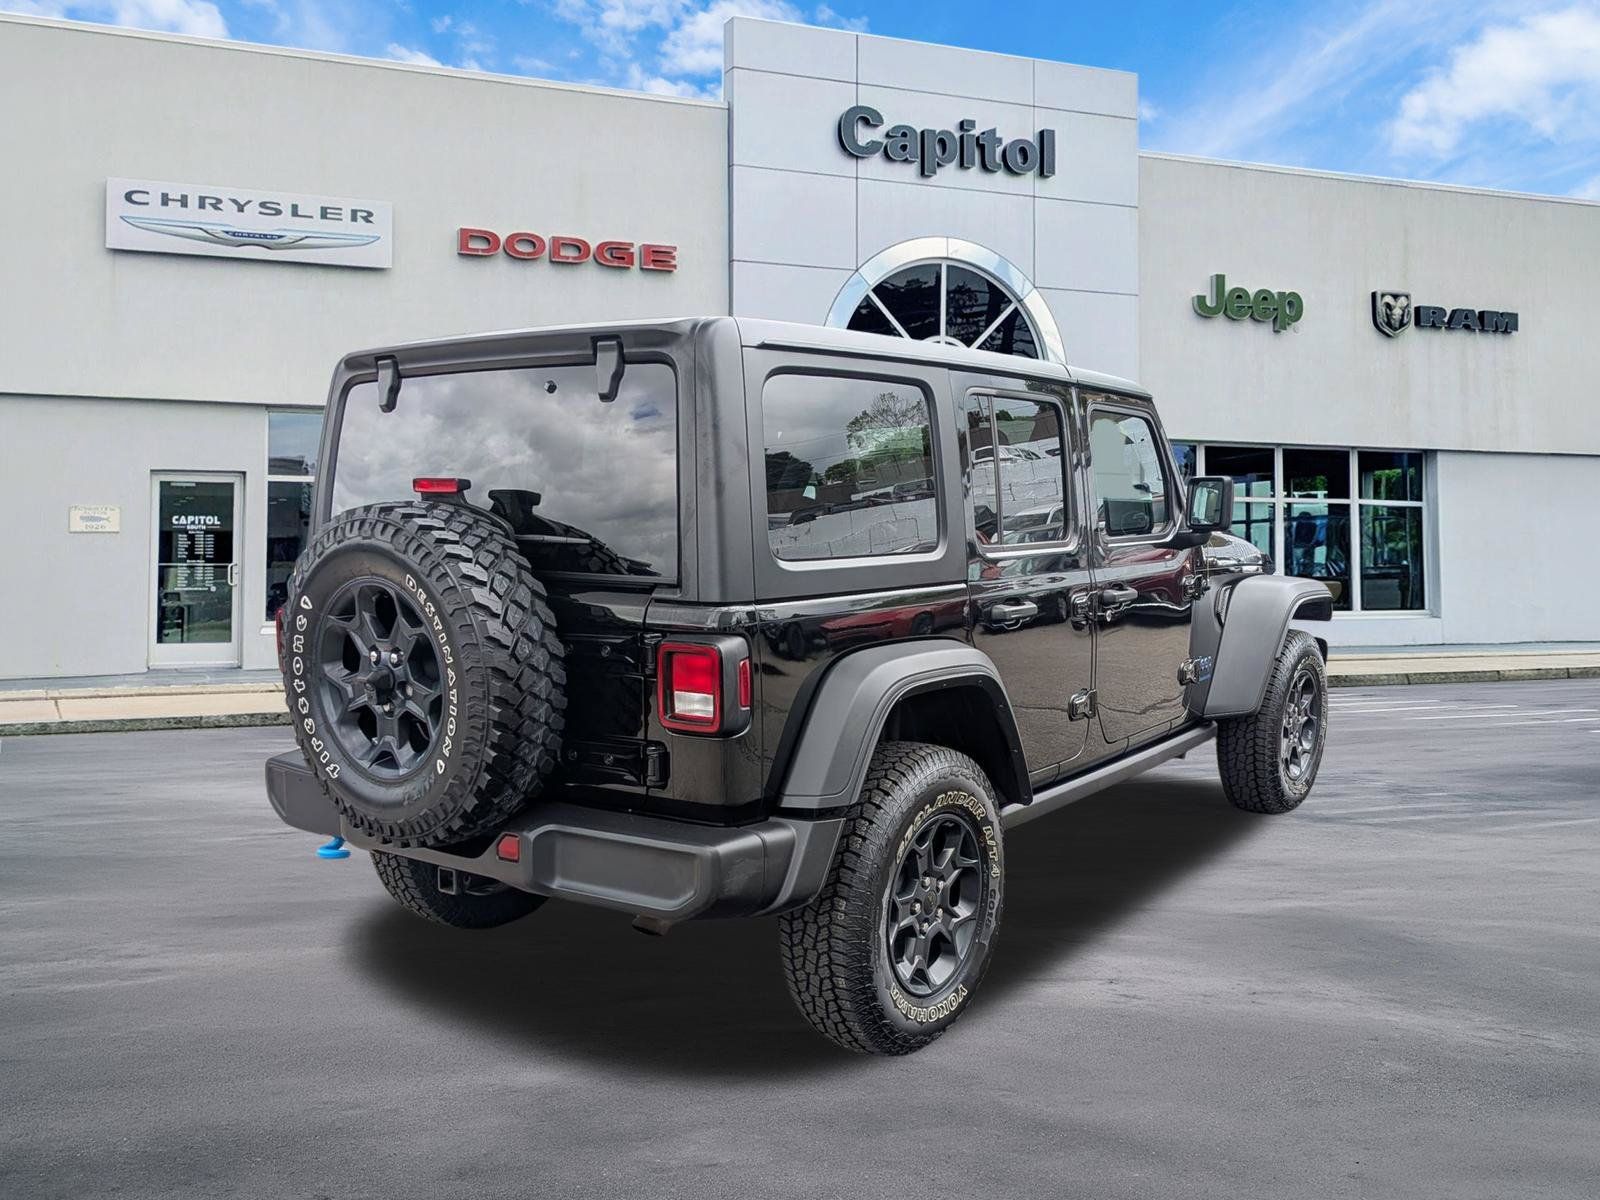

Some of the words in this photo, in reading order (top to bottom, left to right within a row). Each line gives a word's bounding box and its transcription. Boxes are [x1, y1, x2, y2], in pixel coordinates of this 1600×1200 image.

[838, 105, 1056, 178] Capitol
[124, 189, 376, 225] CHRYSLER
[457, 227, 678, 272] DODGE
[1192, 273, 1304, 333] Jeep
[1414, 304, 1519, 334] RAM
[172, 515, 221, 525] CAPITOL
[405, 573, 459, 758] DESTINATION
[890, 982, 968, 1022] YOKOHAMA
